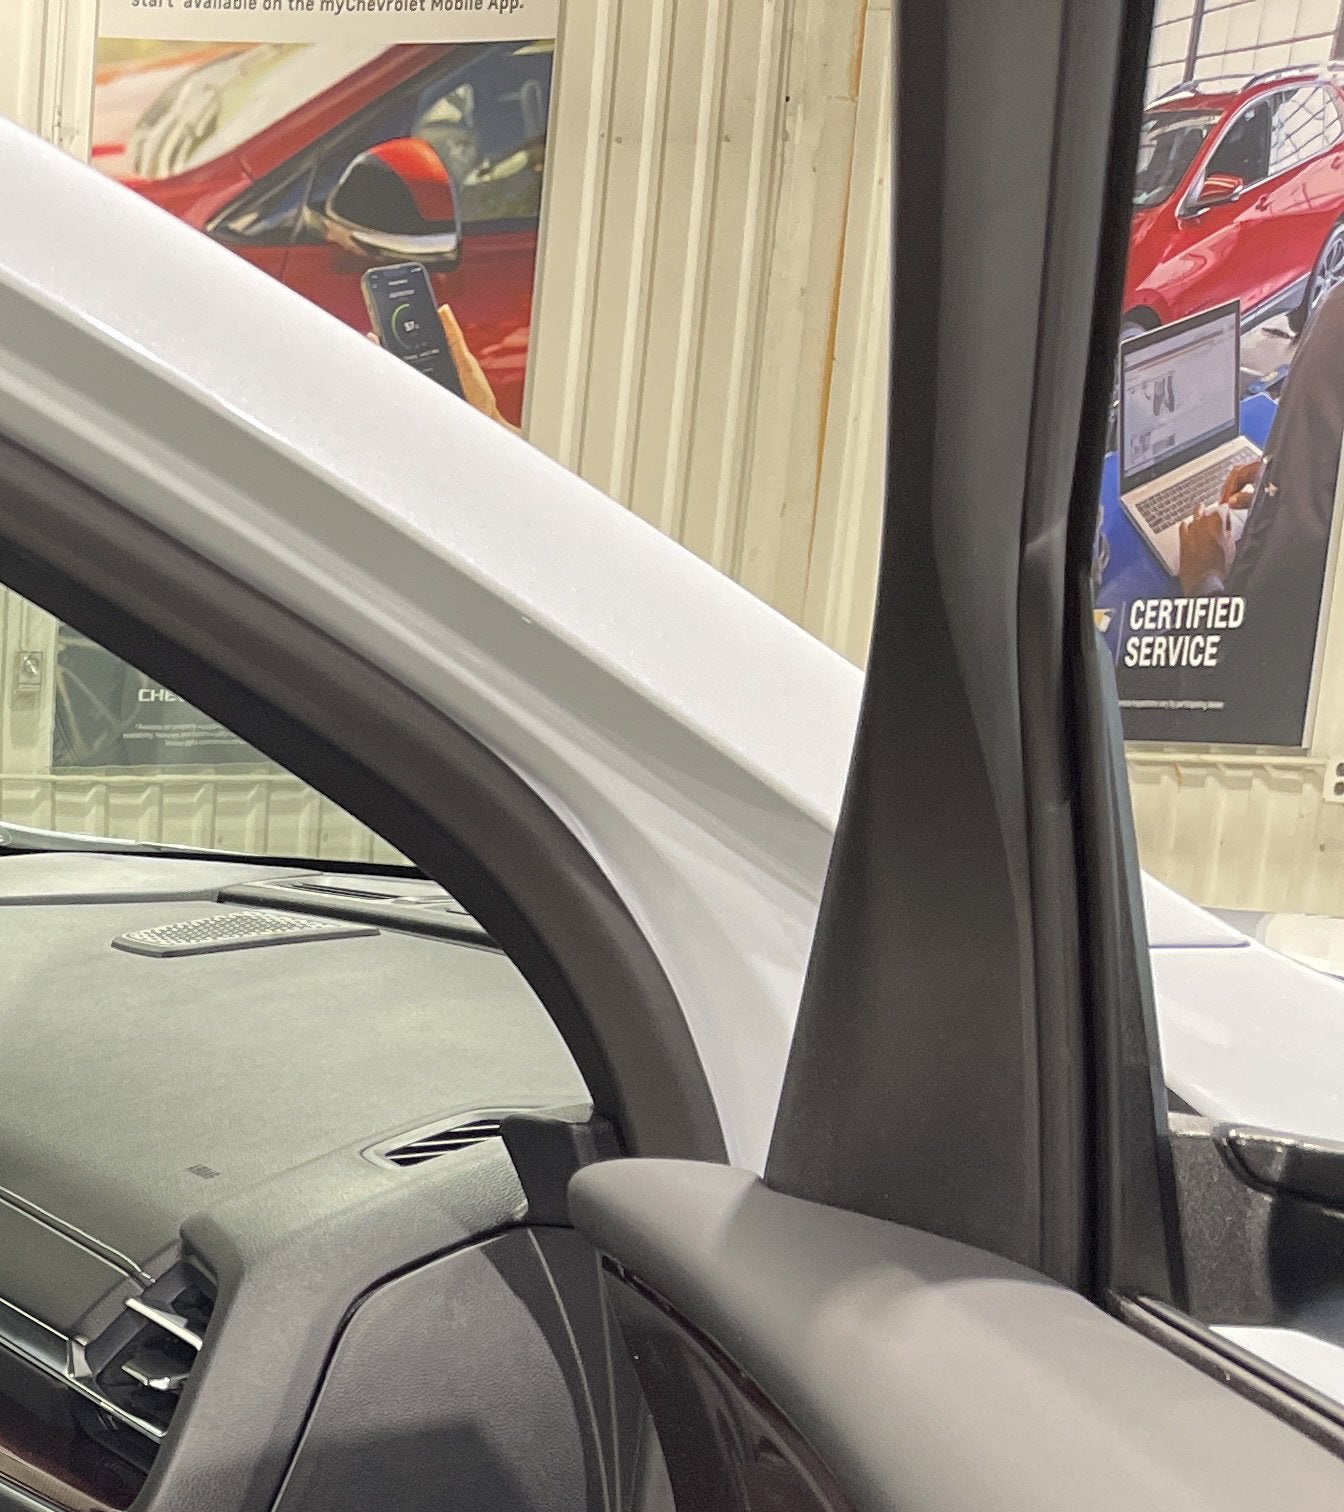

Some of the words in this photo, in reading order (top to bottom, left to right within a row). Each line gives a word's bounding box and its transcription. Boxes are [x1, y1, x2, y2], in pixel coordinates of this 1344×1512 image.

[263, 0, 282, 11] on
[288, 0, 314, 12] the
[1129, 596, 1245, 631] CERTIFIED
[1124, 635, 1222, 667] SERVICE
[138, 688, 185, 702] CHE
